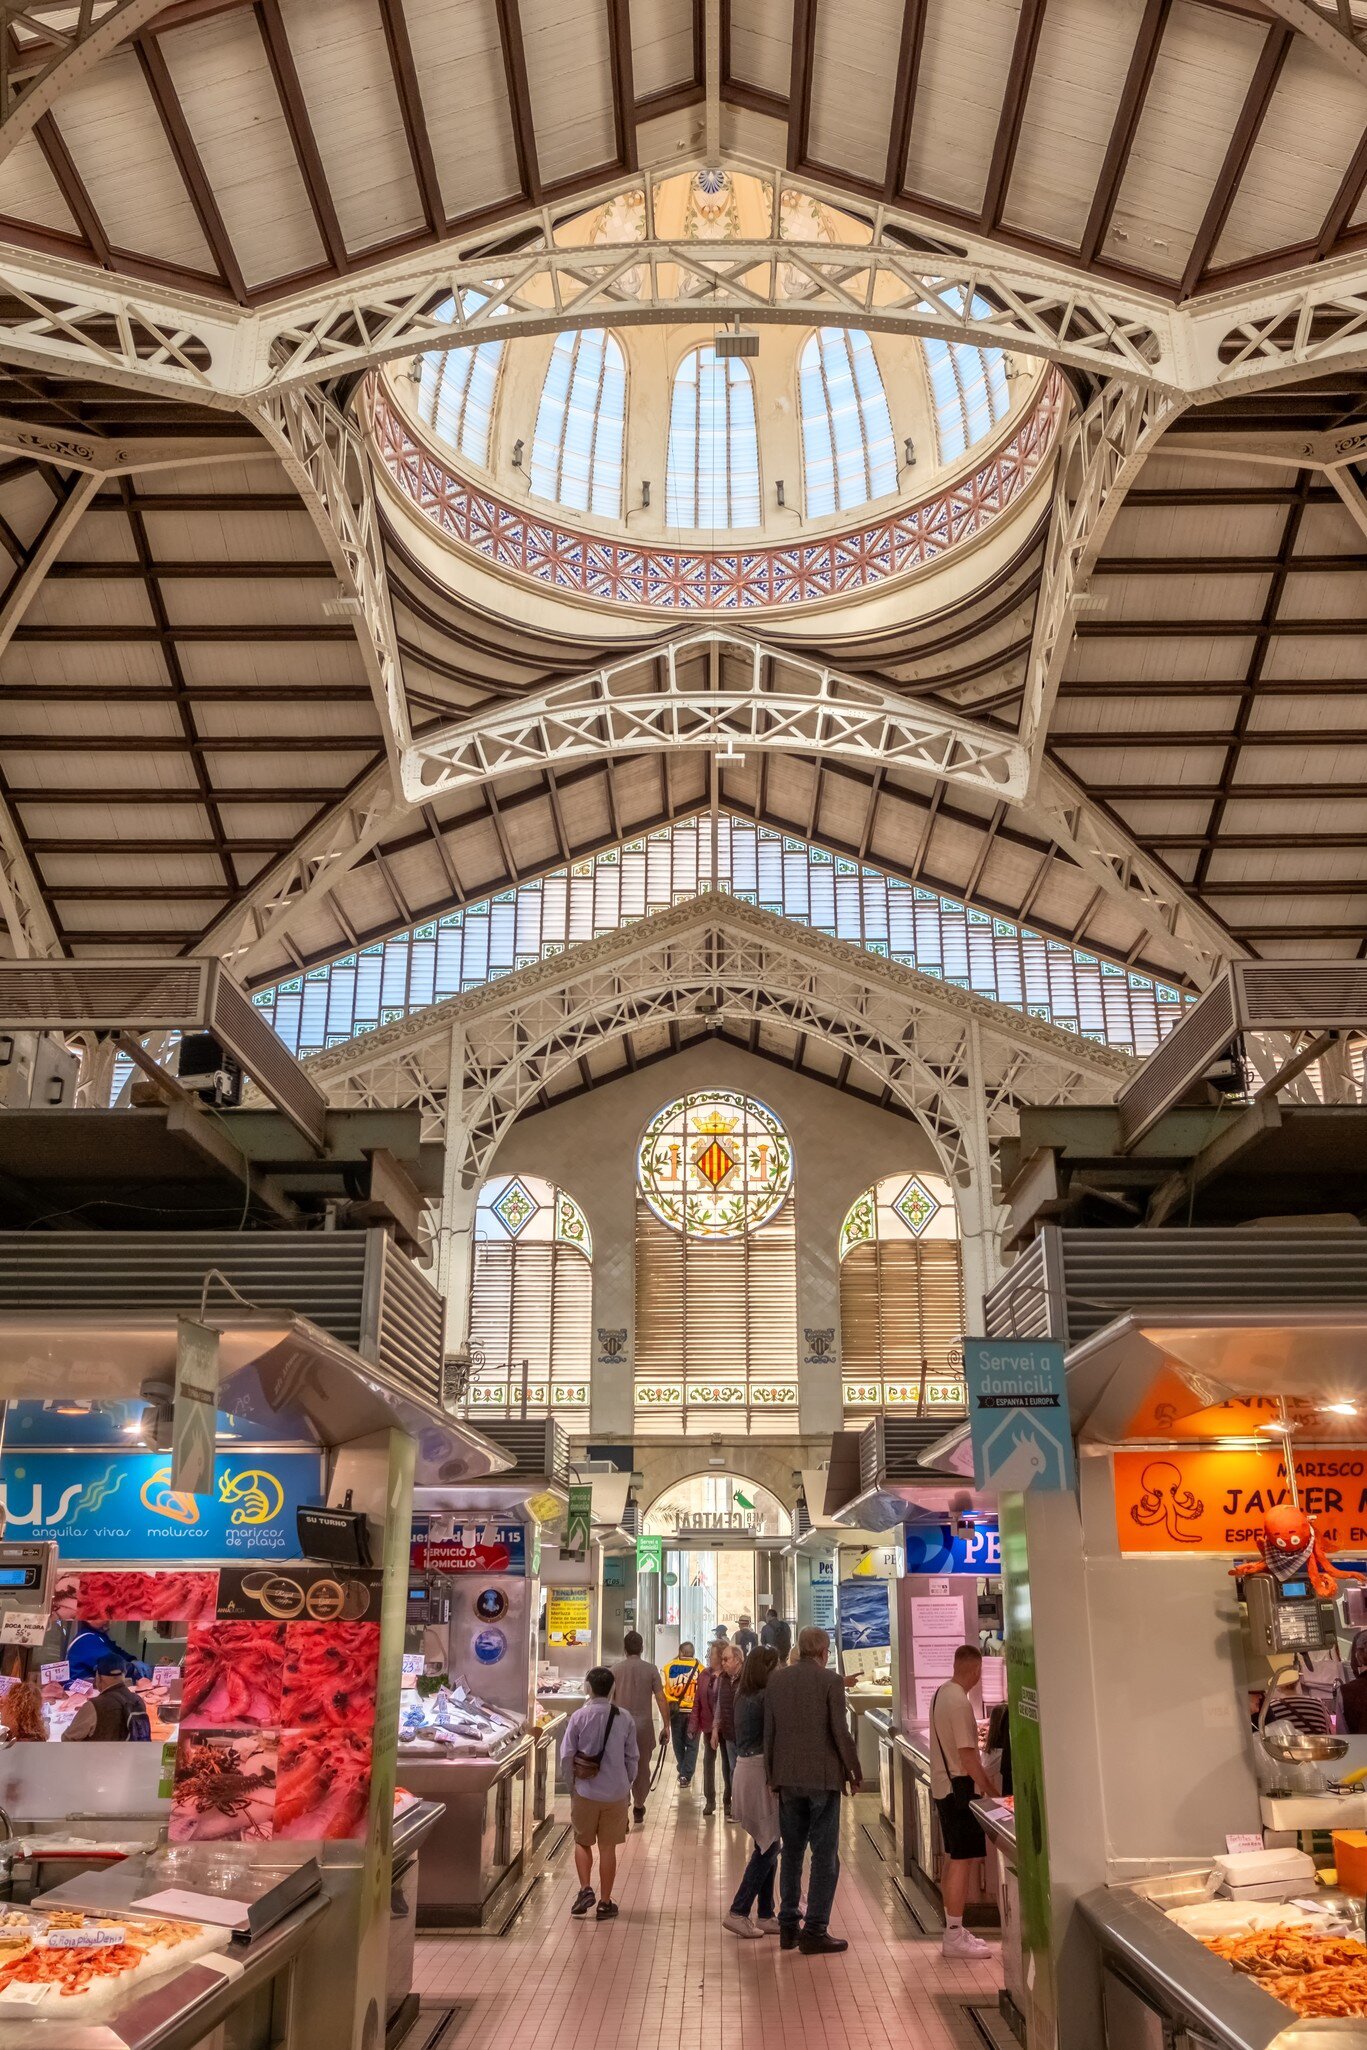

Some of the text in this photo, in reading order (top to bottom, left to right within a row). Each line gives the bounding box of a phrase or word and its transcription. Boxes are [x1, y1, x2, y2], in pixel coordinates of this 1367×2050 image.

[979, 1351, 1051, 1371] Servei a
[981, 1374, 1053, 1394] domicili
[996, 1398, 1024, 1406] ESPANYA
[1029, 1397, 1055, 1406] EUROPA
[306, 1516, 347, 1527] SU TURNO
[32, 1526, 131, 1539] anguilas vivas
[147, 1526, 210, 1537] moluscos
[225, 1527, 284, 1537] mariscos
[508, 1532, 521, 1542] 15
[225, 1536, 286, 1548] de playa
[423, 1548, 477, 1557] SERVICIO A
